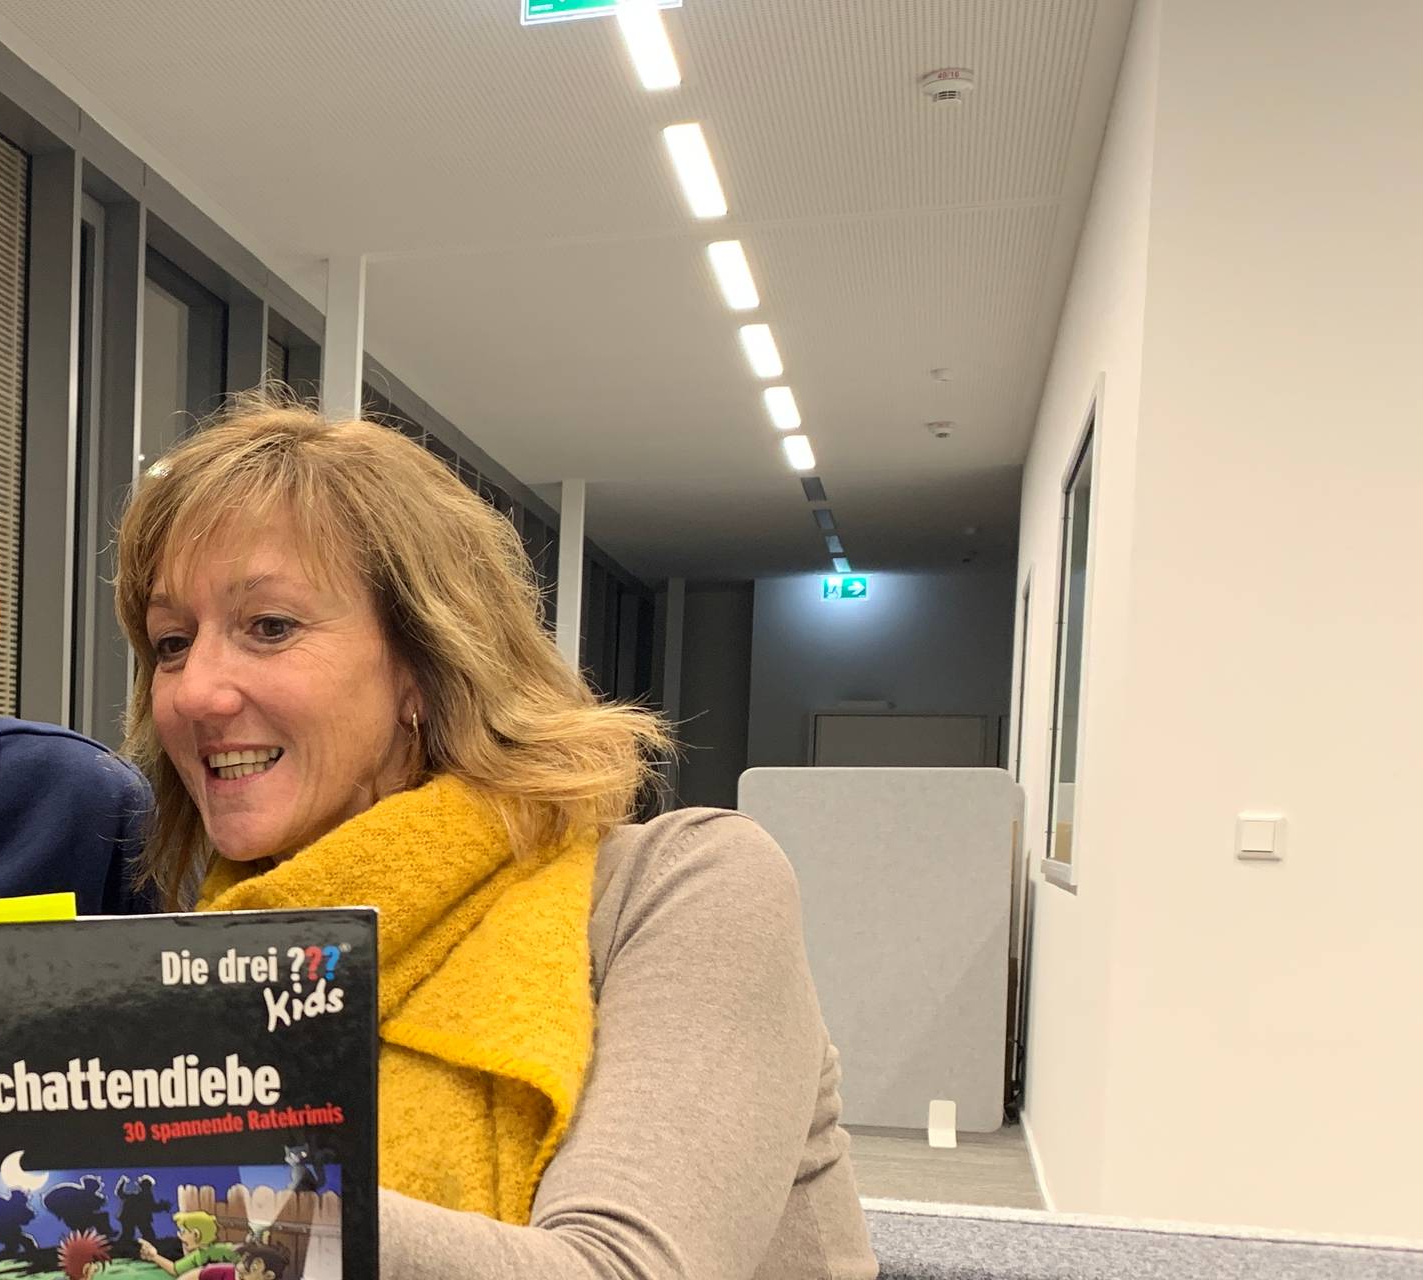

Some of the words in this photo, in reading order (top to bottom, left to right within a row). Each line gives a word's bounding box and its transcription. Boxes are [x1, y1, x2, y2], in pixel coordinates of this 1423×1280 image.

[161, 950, 208, 985] Die
[218, 947, 278, 984] drei
[287, 945, 341, 981] ???
[264, 978, 344, 1032] Kids
[124, 1120, 146, 1142] 30
[151, 1111, 243, 1144] spannende
[249, 1103, 344, 1130] Ratekrimis
